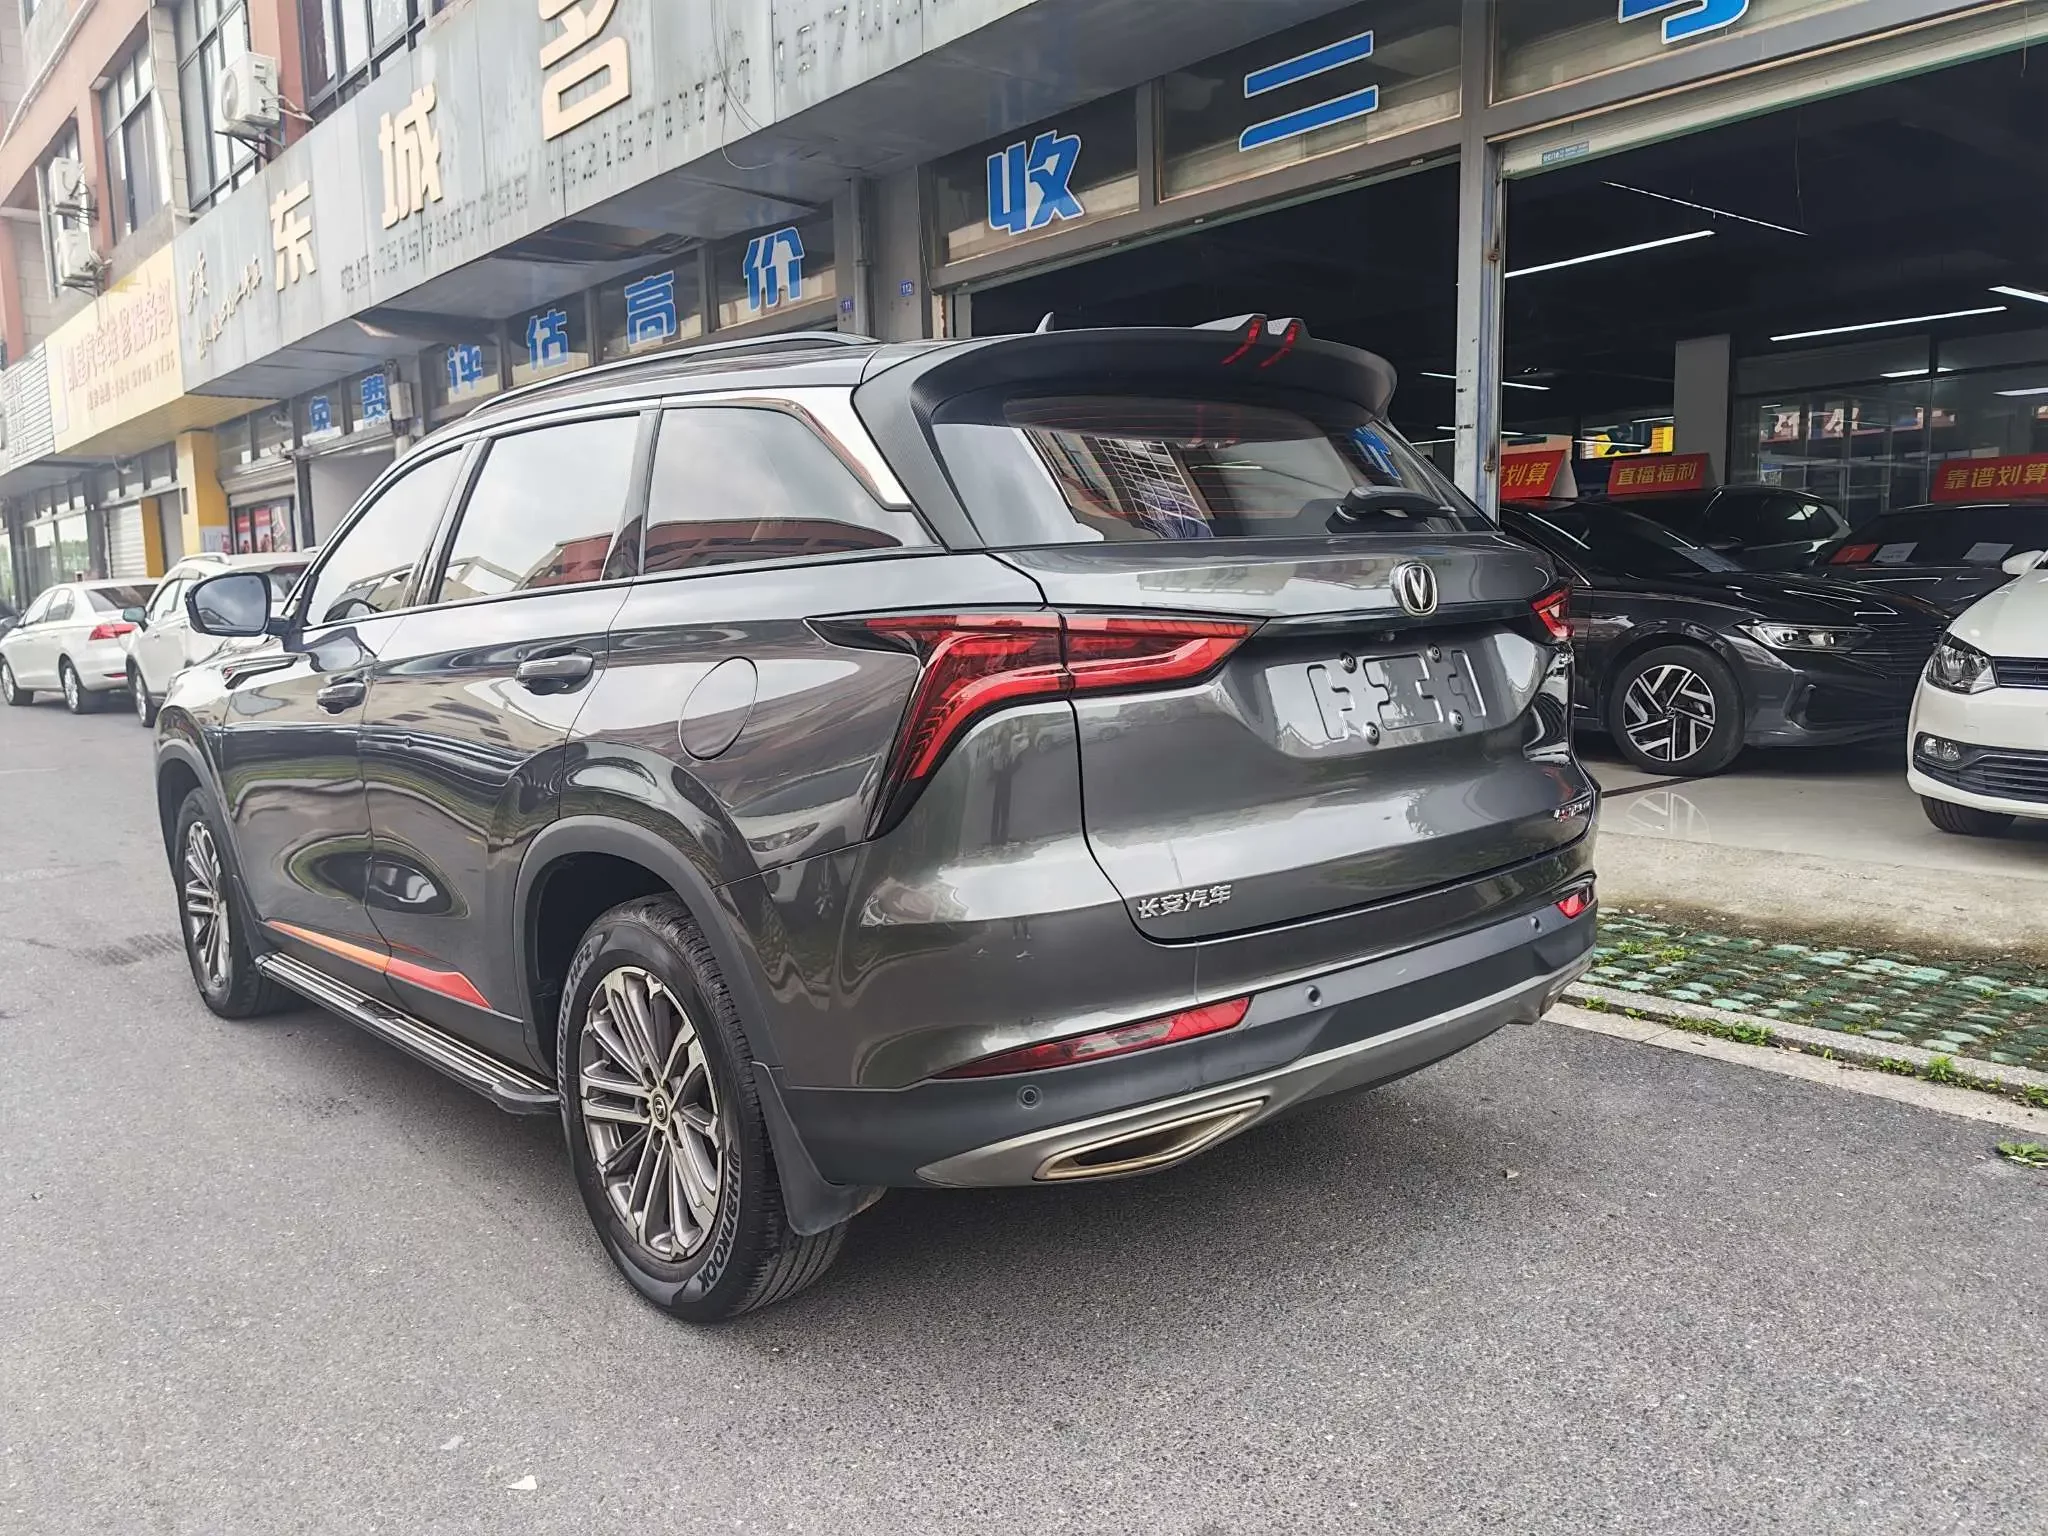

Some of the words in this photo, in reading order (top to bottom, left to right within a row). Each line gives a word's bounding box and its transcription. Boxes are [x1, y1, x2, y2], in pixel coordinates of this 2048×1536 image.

[1500, 462, 1551, 488] 划算
[1616, 462, 1696, 486] 直播福利
[1944, 463, 2048, 490] 靠谱划算
[1138, 884, 1232, 919] 长安汽车
[570, 943, 593, 985] HP2
